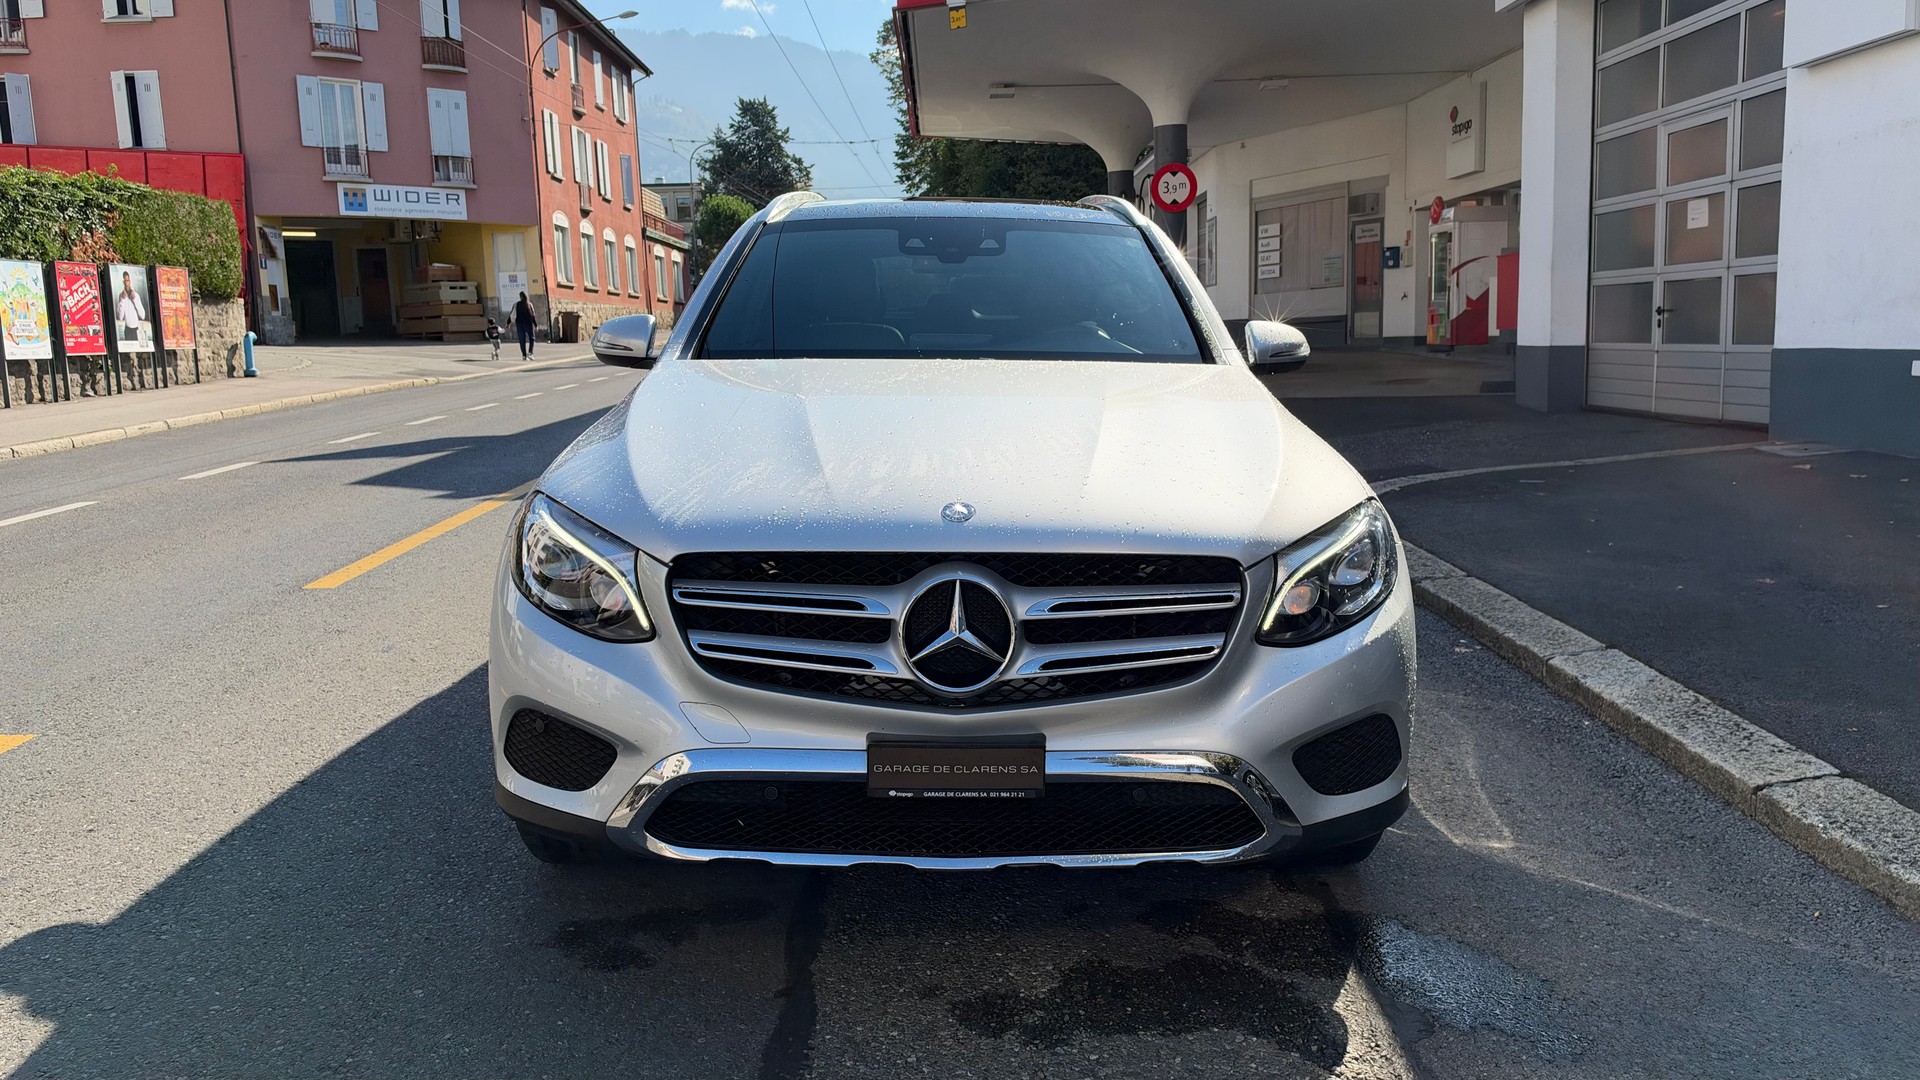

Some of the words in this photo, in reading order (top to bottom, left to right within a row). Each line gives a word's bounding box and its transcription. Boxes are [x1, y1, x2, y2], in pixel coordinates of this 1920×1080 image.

[373, 189, 461, 206] WIDER
[67, 282, 91, 308] BACH
[873, 764, 930, 773] GARAGE
[933, 765, 951, 773] DE
[954, 765, 1017, 774] CLARENS
[1020, 765, 1039, 774] SA
